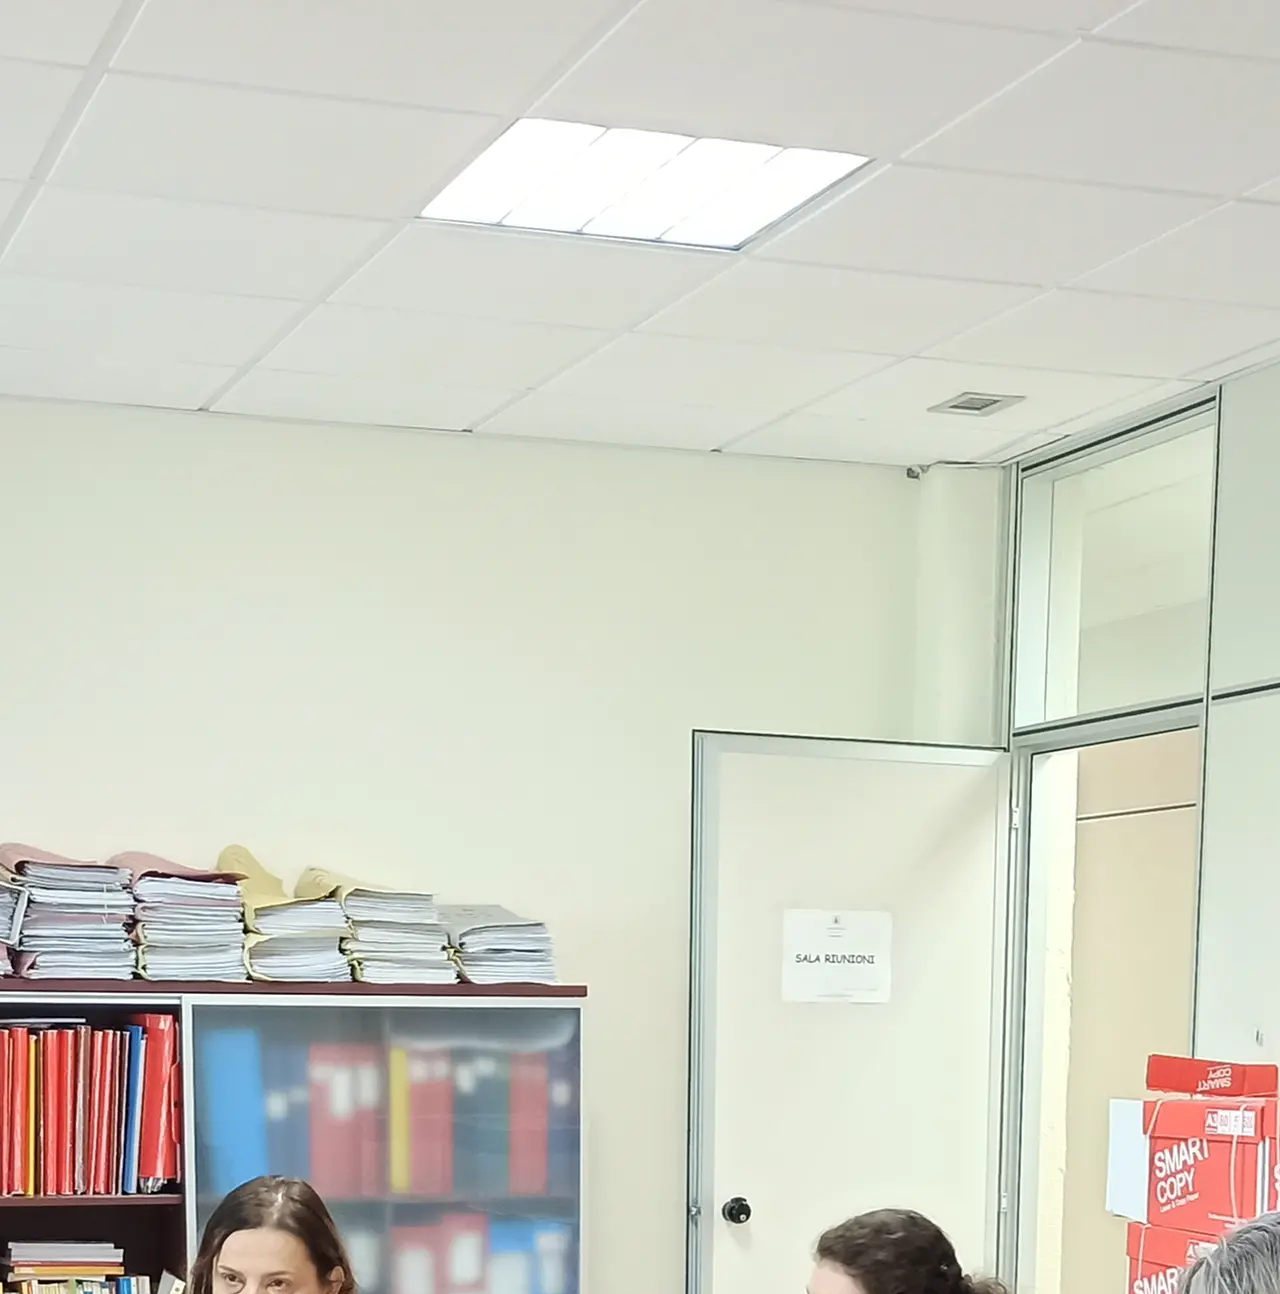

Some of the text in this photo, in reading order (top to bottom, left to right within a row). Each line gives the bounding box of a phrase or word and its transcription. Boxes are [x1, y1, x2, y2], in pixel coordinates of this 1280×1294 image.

[795, 953, 875, 964] SALA RIUNIONI
[1208, 1067, 1232, 1079] COPY
[1197, 1077, 1232, 1091] SMART
[1156, 1167, 1195, 1205] COPY
